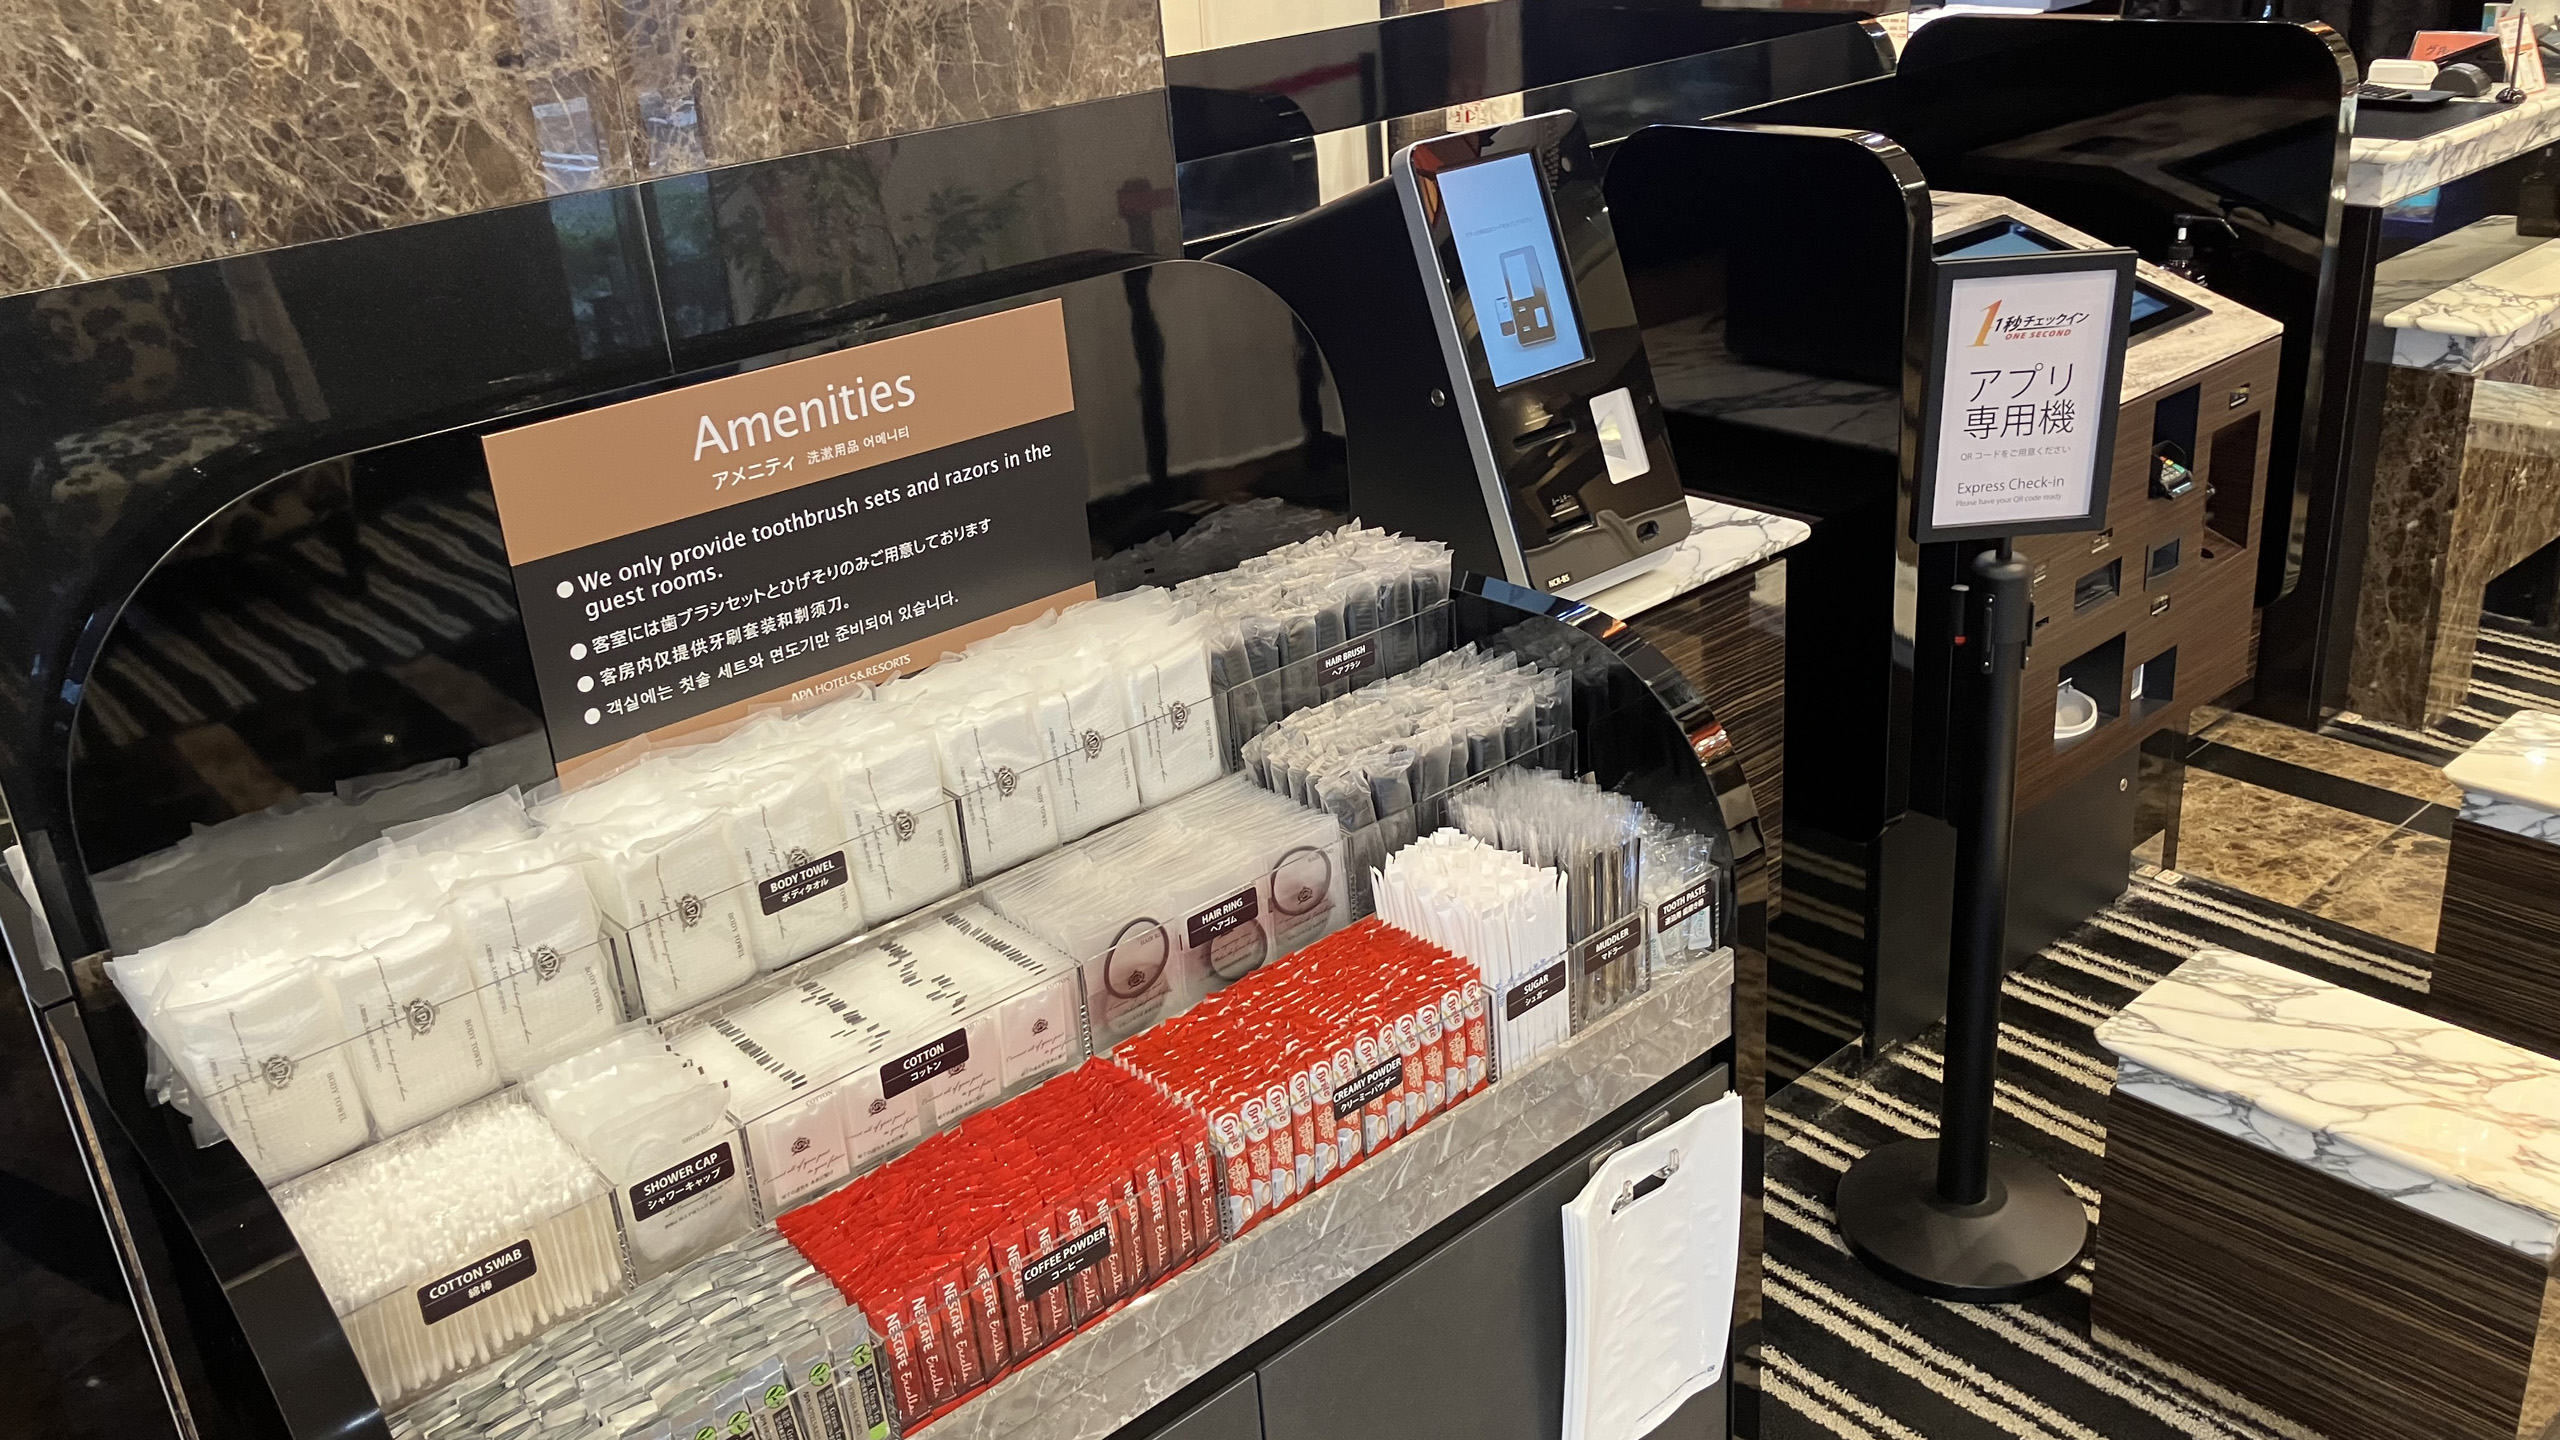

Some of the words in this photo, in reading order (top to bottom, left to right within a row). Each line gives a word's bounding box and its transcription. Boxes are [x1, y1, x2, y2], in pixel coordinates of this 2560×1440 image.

[2005, 331, 2026, 340] ONE
[2028, 329, 2072, 339] SECOND
[1970, 362, 2074, 403] アプリ
[694, 375, 916, 461] Amenities
[1963, 400, 2075, 440] 専用機
[863, 425, 910, 448] 어메니티
[807, 440, 860, 465] 洗漱用品
[712, 456, 795, 491] アメニティ
[1957, 481, 2005, 496] Express
[2009, 476, 2065, 490] Check-in
[1956, 499, 1977, 507] Please
[1996, 497, 2012, 505] your
[2024, 494, 2041, 502] code
[2043, 493, 2062, 501] ready
[578, 570, 612, 593] We
[618, 555, 663, 582] only
[670, 531, 747, 571] provide
[752, 497, 859, 543] toothbrush
[864, 487, 901, 510] sets
[906, 472, 940, 498] and
[945, 459, 999, 487] razors
[1004, 452, 1020, 469] in
[1024, 443, 1052, 464] the
[585, 586, 645, 622] guest
[651, 565, 723, 598] rooms.
[591, 517, 991, 655] 客室には歯ブラシセットとひげそりのみご用意しております
[606, 685, 673, 716] 객실에는
[679, 671, 711, 694] 칫솔
[717, 653, 764, 679] 세트와
[769, 630, 830, 665] 면도기만
[835, 610, 893, 643] 준비되어
[898, 590, 959, 623] 있습니다.
[1325, 654, 1342, 668] HAIR
[1343, 645, 1366, 661] BRUSH
[1332, 661, 1360, 675] ヘアブラシ
[791, 687, 814, 703] APA
[770, 872, 799, 893] BODY
[800, 860, 835, 881] TOWEL
[781, 877, 829, 903] ボディタオル
[1202, 908, 1222, 924] HAIR
[1223, 898, 1243, 914] RING
[1663, 896, 1685, 915] TOOTH
[1687, 884, 1706, 902] PASTE
[727, 912, 738, 936] BODY
[733, 934, 745, 960] TOWEL
[1210, 916, 1237, 932] ヘアゴム
[1596, 928, 1630, 953] MUDDLER
[1600, 944, 1625, 961] マドラー
[1523, 973, 1549, 994] SUGAR
[592, 989, 604, 1014] TOWEL
[1525, 989, 1549, 1006] シュガー
[465, 1018, 476, 1042] BODY
[472, 1042, 483, 1069] TOWEL
[903, 1042, 945, 1070] COTTON
[910, 1060, 942, 1082] コットン
[1316, 1071, 1331, 1098] Brite
[1333, 1076, 1366, 1104] CREAMY
[1367, 1057, 1401, 1084] POWDER
[806, 1089, 834, 1107] COTTON
[1295, 1081, 1311, 1108] Brite
[1340, 1075, 1397, 1112] クリーミーパウダー
[334, 1094, 348, 1124] TOWEL
[1248, 1108, 1264, 1135] Brite
[1270, 1095, 1287, 1123] Brite
[1222, 1123, 1240, 1149] Brite
[643, 1164, 694, 1197] SHOWER
[695, 1152, 719, 1173] CAP
[647, 1167, 721, 1210] シャワーキャップ
[1024, 1249, 1063, 1282] COFFEE
[1063, 1227, 1107, 1261] POWDER
[429, 1265, 484, 1300] COTTON
[485, 1248, 523, 1274] SWAB
[1051, 1257, 1084, 1281] コーヒー
